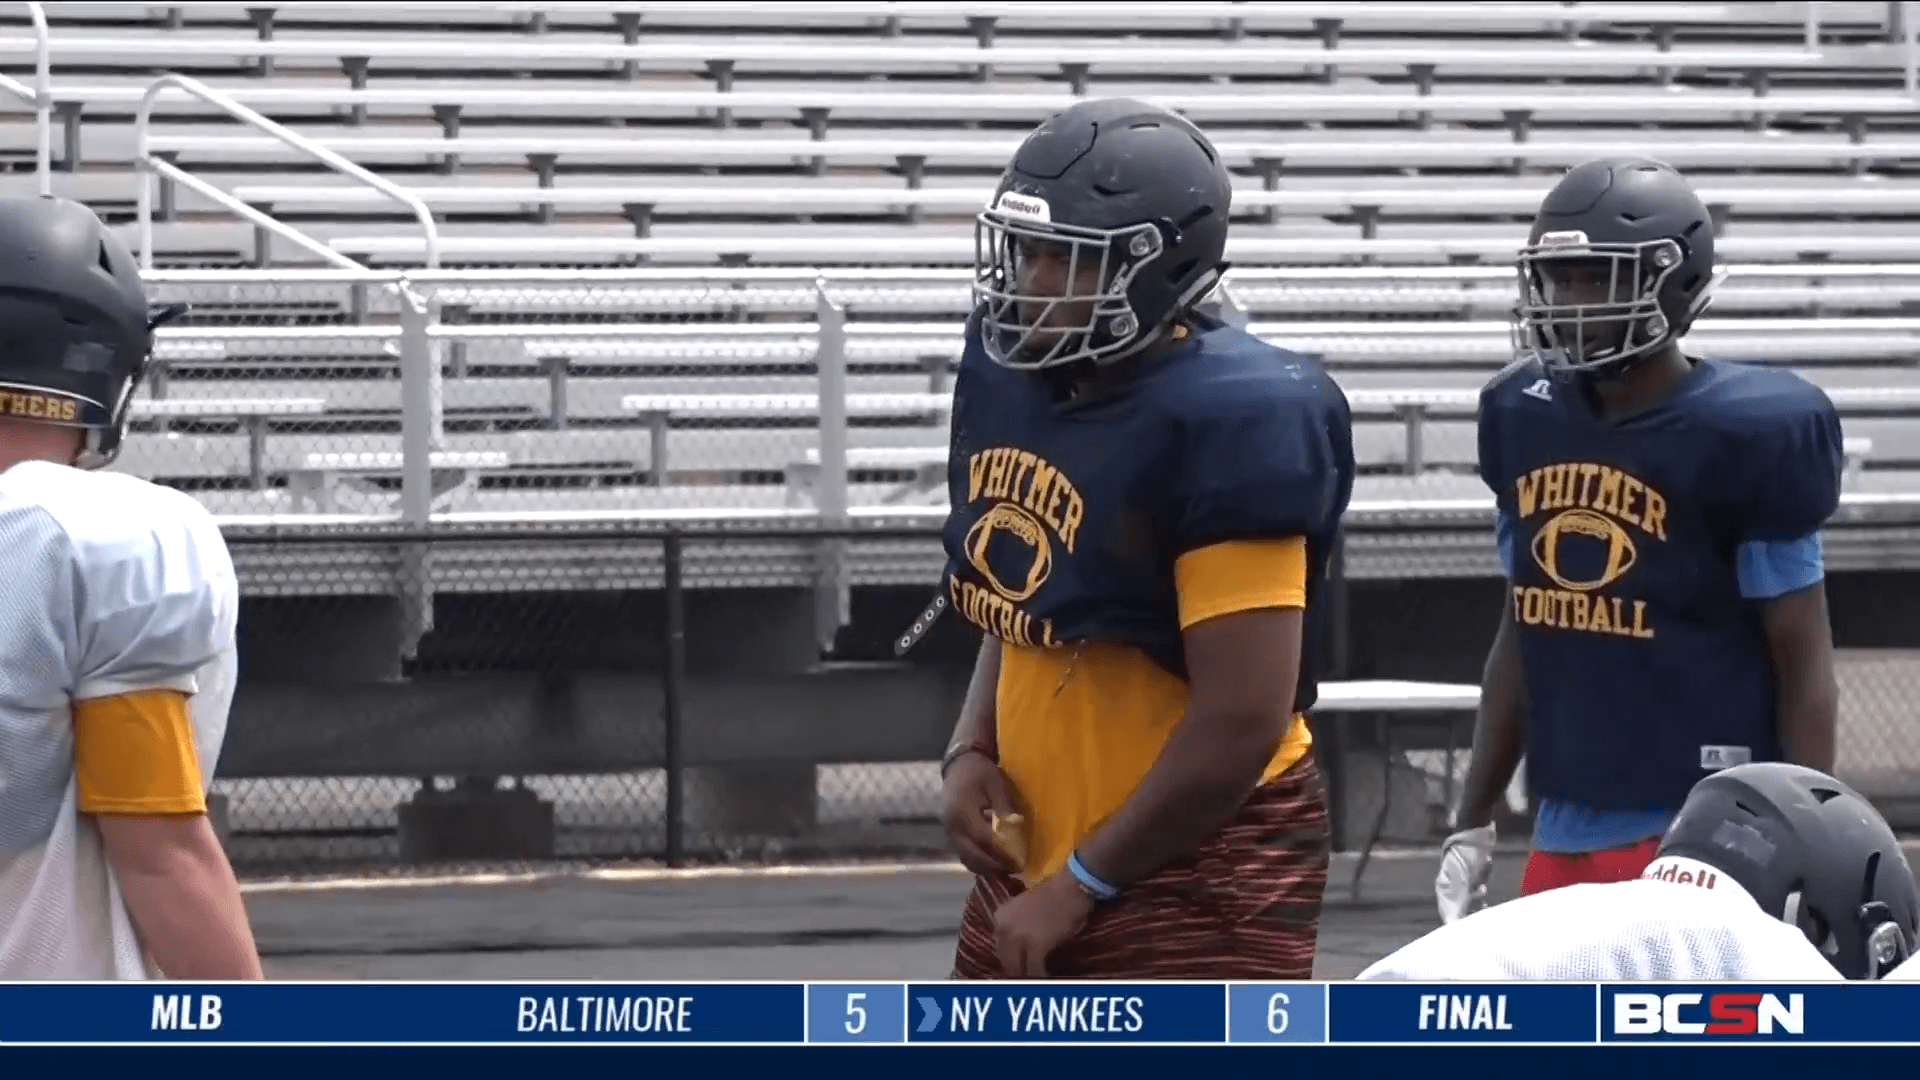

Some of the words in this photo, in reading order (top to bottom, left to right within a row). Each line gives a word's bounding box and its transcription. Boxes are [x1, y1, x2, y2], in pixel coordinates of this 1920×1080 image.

[968, 447, 1084, 554] WHITMER
[1515, 462, 1668, 542] WHITMER
[1512, 585, 1655, 639] FOOTBALL
[1650, 863, 1717, 890] ddell
